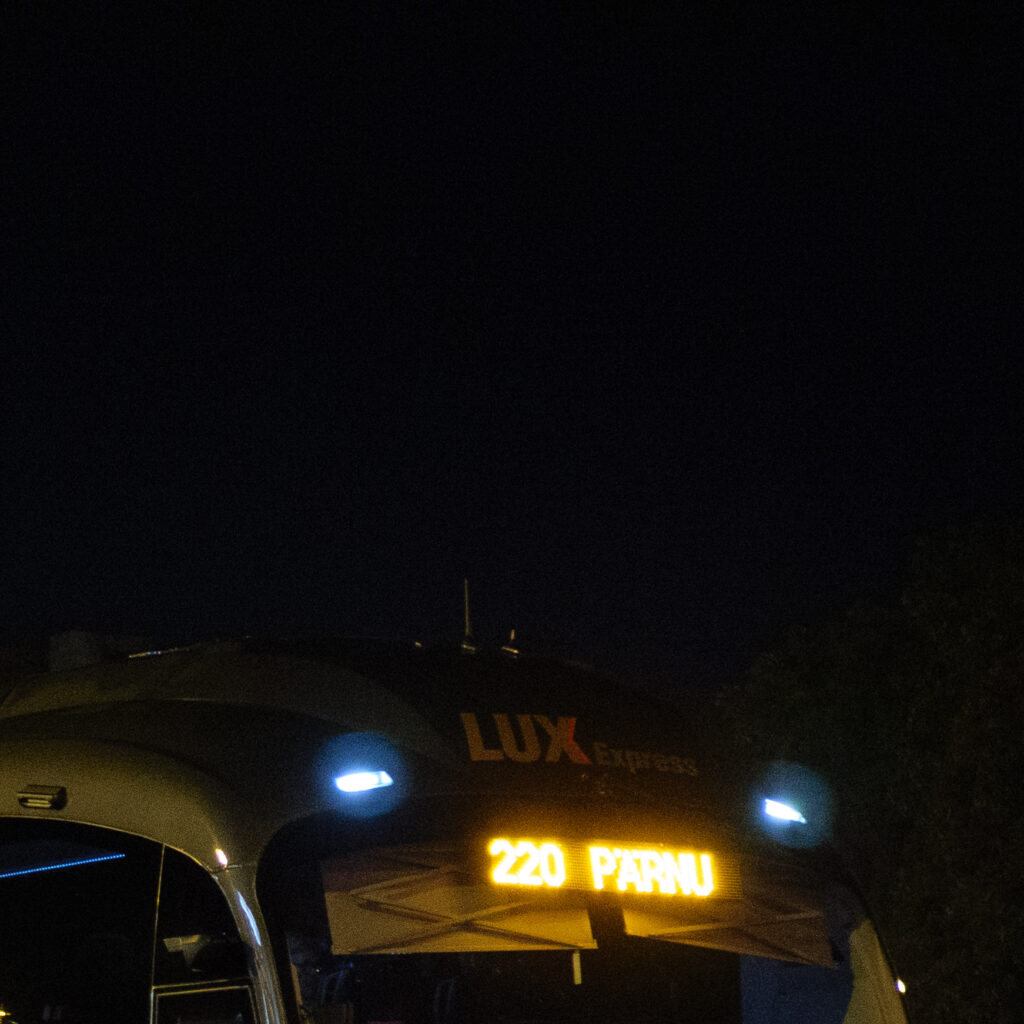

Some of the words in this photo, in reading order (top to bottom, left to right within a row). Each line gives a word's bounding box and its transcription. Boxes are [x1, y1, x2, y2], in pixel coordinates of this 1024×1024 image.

[460, 712, 592, 765] LUX
[592, 742, 699, 777] Express
[488, 838, 567, 888] 220
[588, 845, 715, 898] PÄRNU
